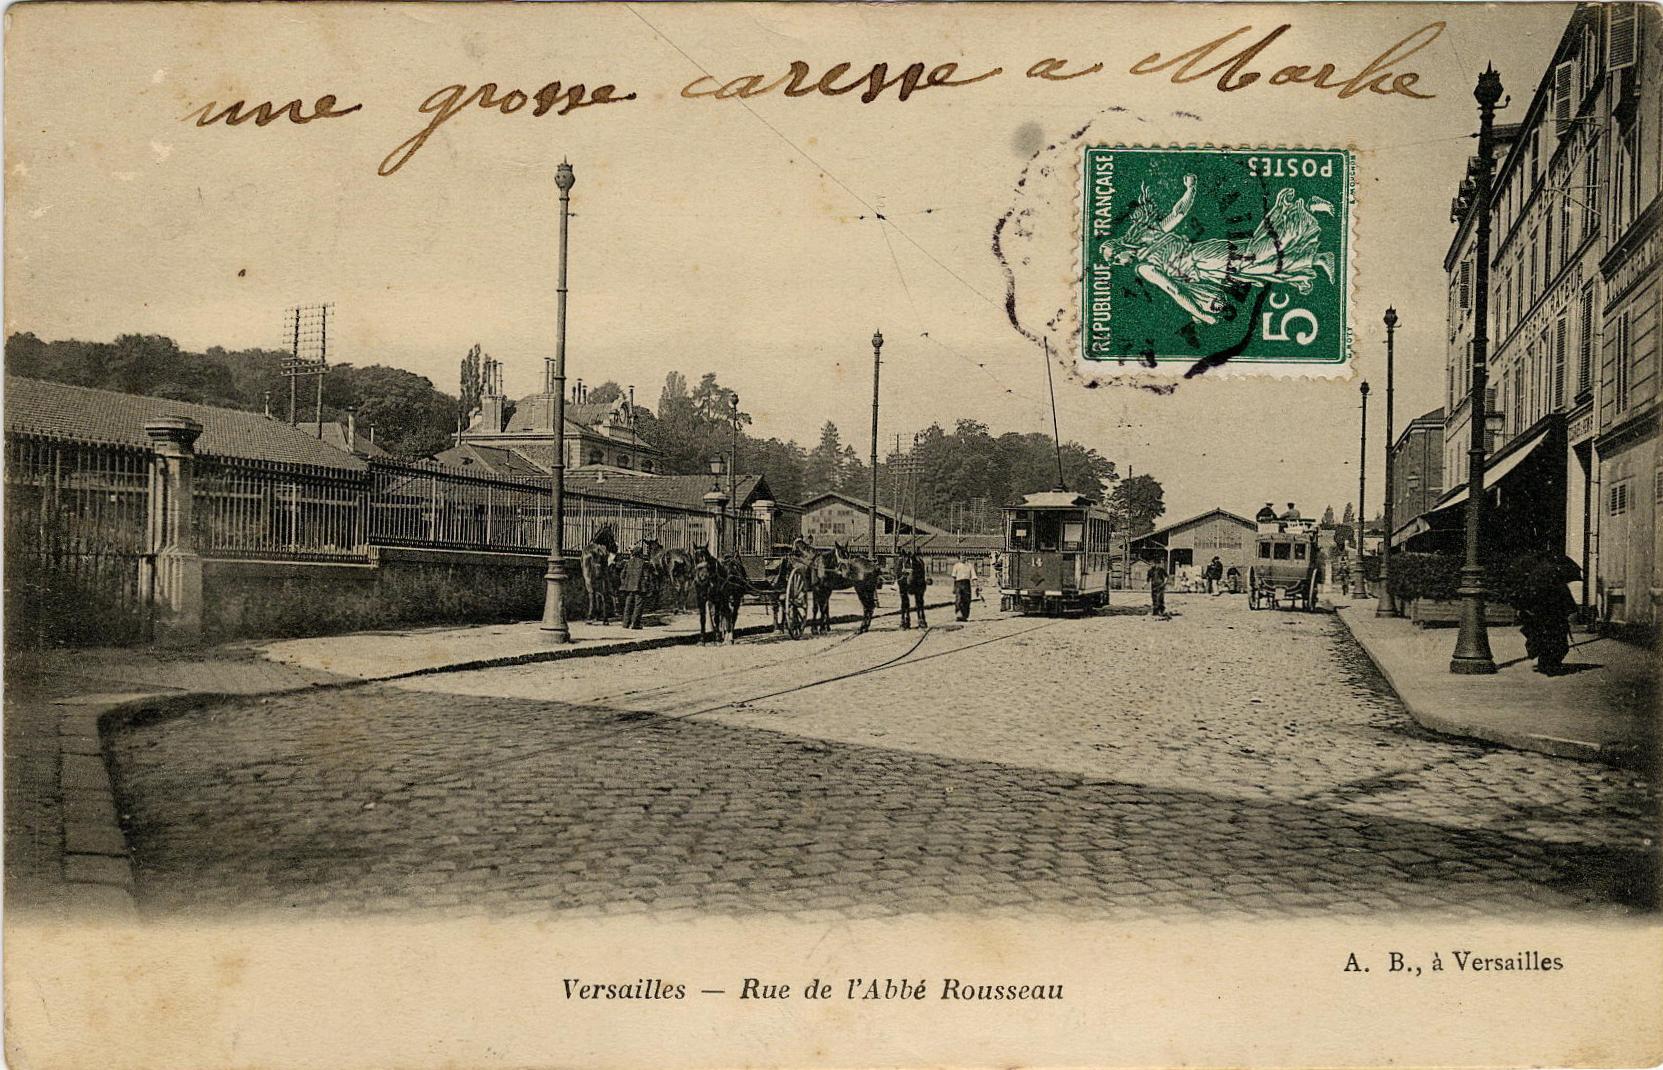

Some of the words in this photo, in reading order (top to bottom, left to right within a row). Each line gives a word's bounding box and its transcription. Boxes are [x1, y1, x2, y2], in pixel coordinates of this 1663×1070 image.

[182, 93, 362, 127] une
[378, 80, 637, 176] grosse
[681, 60, 1003, 102] caresse
[1094, 155, 1116, 237] FRANÇAISE
[1247, 156, 1333, 178] POSTES
